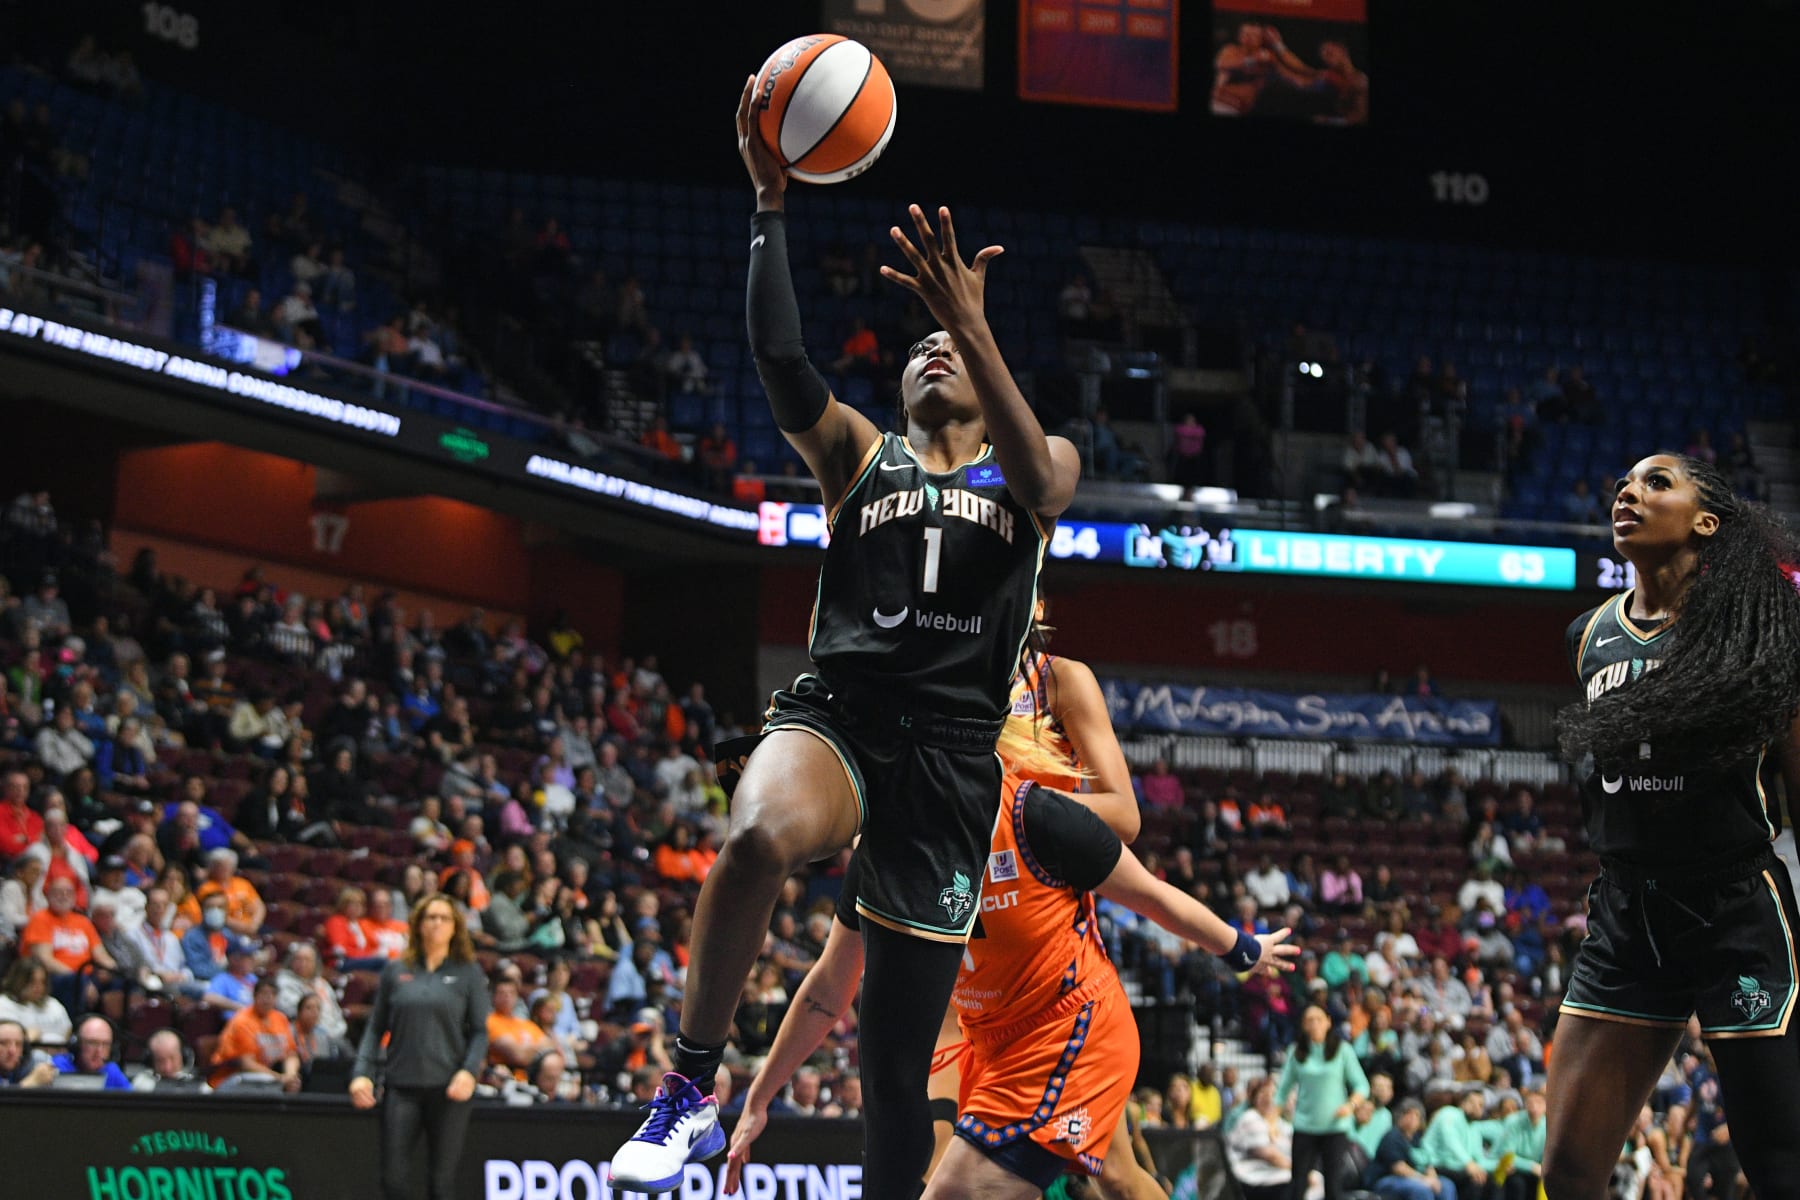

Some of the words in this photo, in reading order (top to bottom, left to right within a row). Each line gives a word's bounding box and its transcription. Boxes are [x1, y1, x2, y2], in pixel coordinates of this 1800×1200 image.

[142, 2, 199, 47] 108
[1431, 171, 1488, 205] 110
[10, 313, 44, 338] AT
[42, 320, 84, 349] THE
[80, 331, 169, 372] NEAREST
[163, 355, 228, 389] ARENA
[227, 372, 344, 421] CONCESSIONS
[341, 403, 400, 437] BOOTH
[526, 455, 606, 494] AVAILABLE
[604, 476, 626, 498] AT
[623, 480, 653, 505] THE
[650, 488, 712, 521] NEAREST
[311, 514, 349, 553] 17
[859, 487, 924, 538] NEW
[941, 488, 1015, 545] YORK
[923, 526, 943, 594] 1
[1251, 537, 1445, 576] LIBERTY
[915, 609, 982, 635] Webull
[1586, 659, 1630, 708] NEW
[1132, 684, 1289, 731] Mohegan
[1293, 695, 1370, 734] Sun
[1376, 696, 1491, 738] Arena
[1629, 775, 1684, 791] Webull
[993, 863, 1015, 876] Post
[980, 890, 1020, 912] CUT
[139, 1130, 230, 1157] TEQUILA
[86, 1166, 293, 1200] HORNITOS
